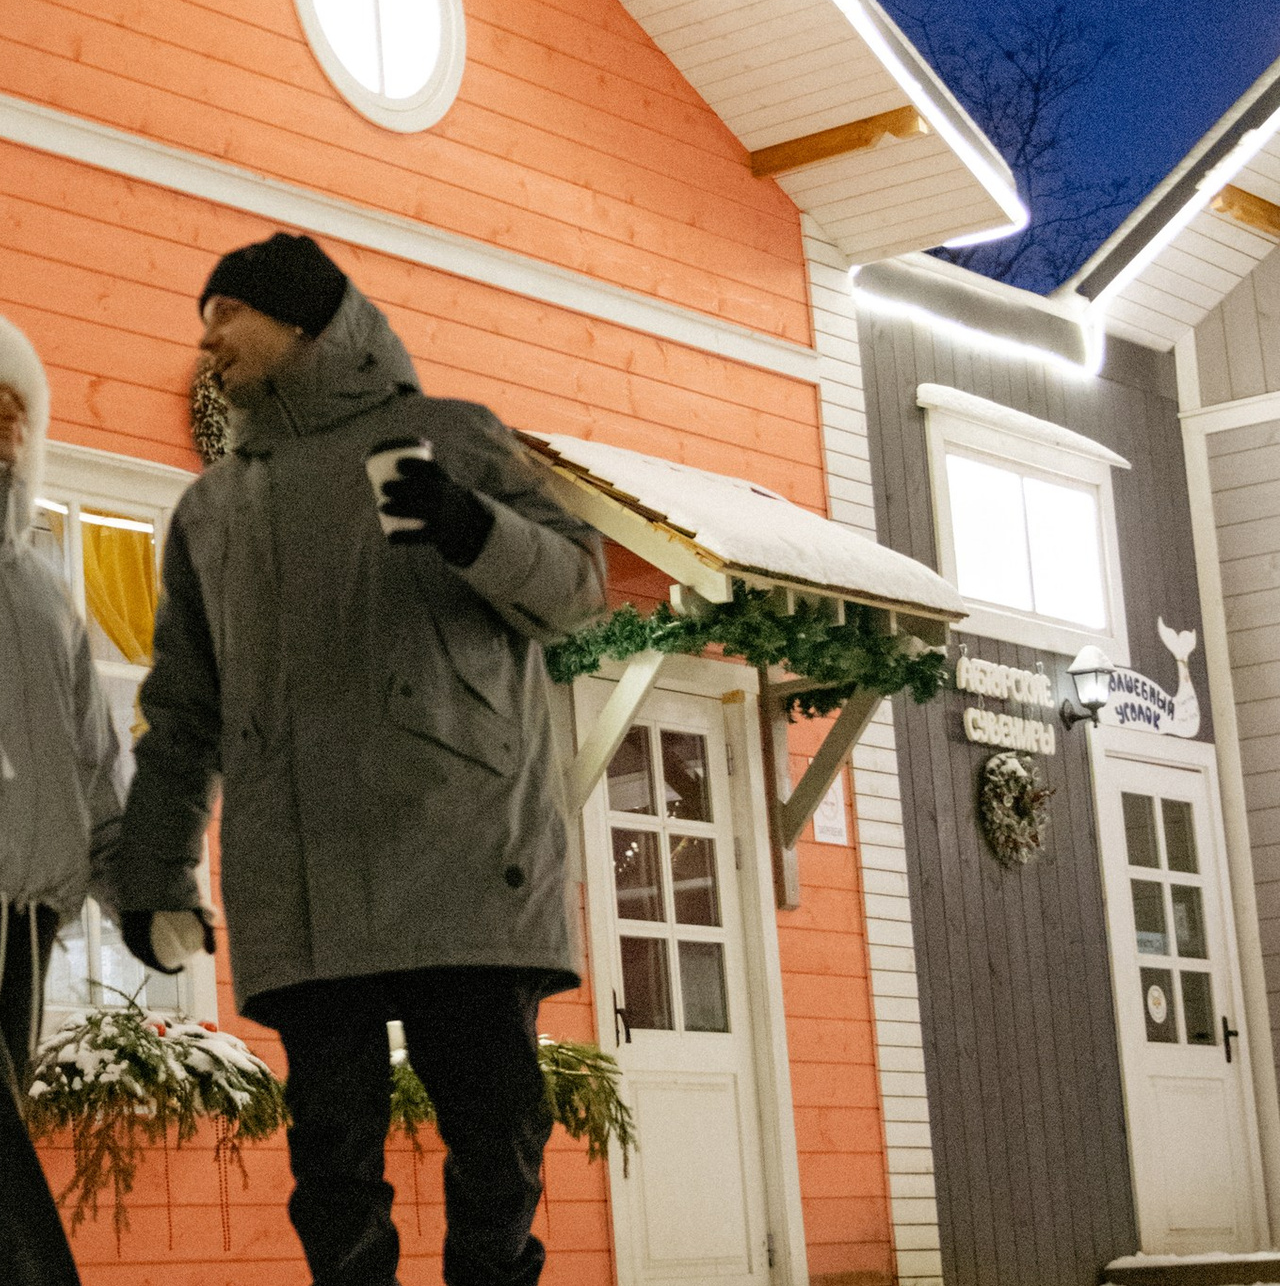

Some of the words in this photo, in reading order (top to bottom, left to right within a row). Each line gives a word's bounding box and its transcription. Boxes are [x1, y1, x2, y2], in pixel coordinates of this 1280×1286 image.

[956, 656, 1055, 709] АВТОРСКИЕ
[1108, 672, 1175, 721] ОЛШЕБНЫЙ
[963, 707, 1056, 755] СУВЕНИРЫ
[1115, 701, 1161, 731] УГОЛОК
